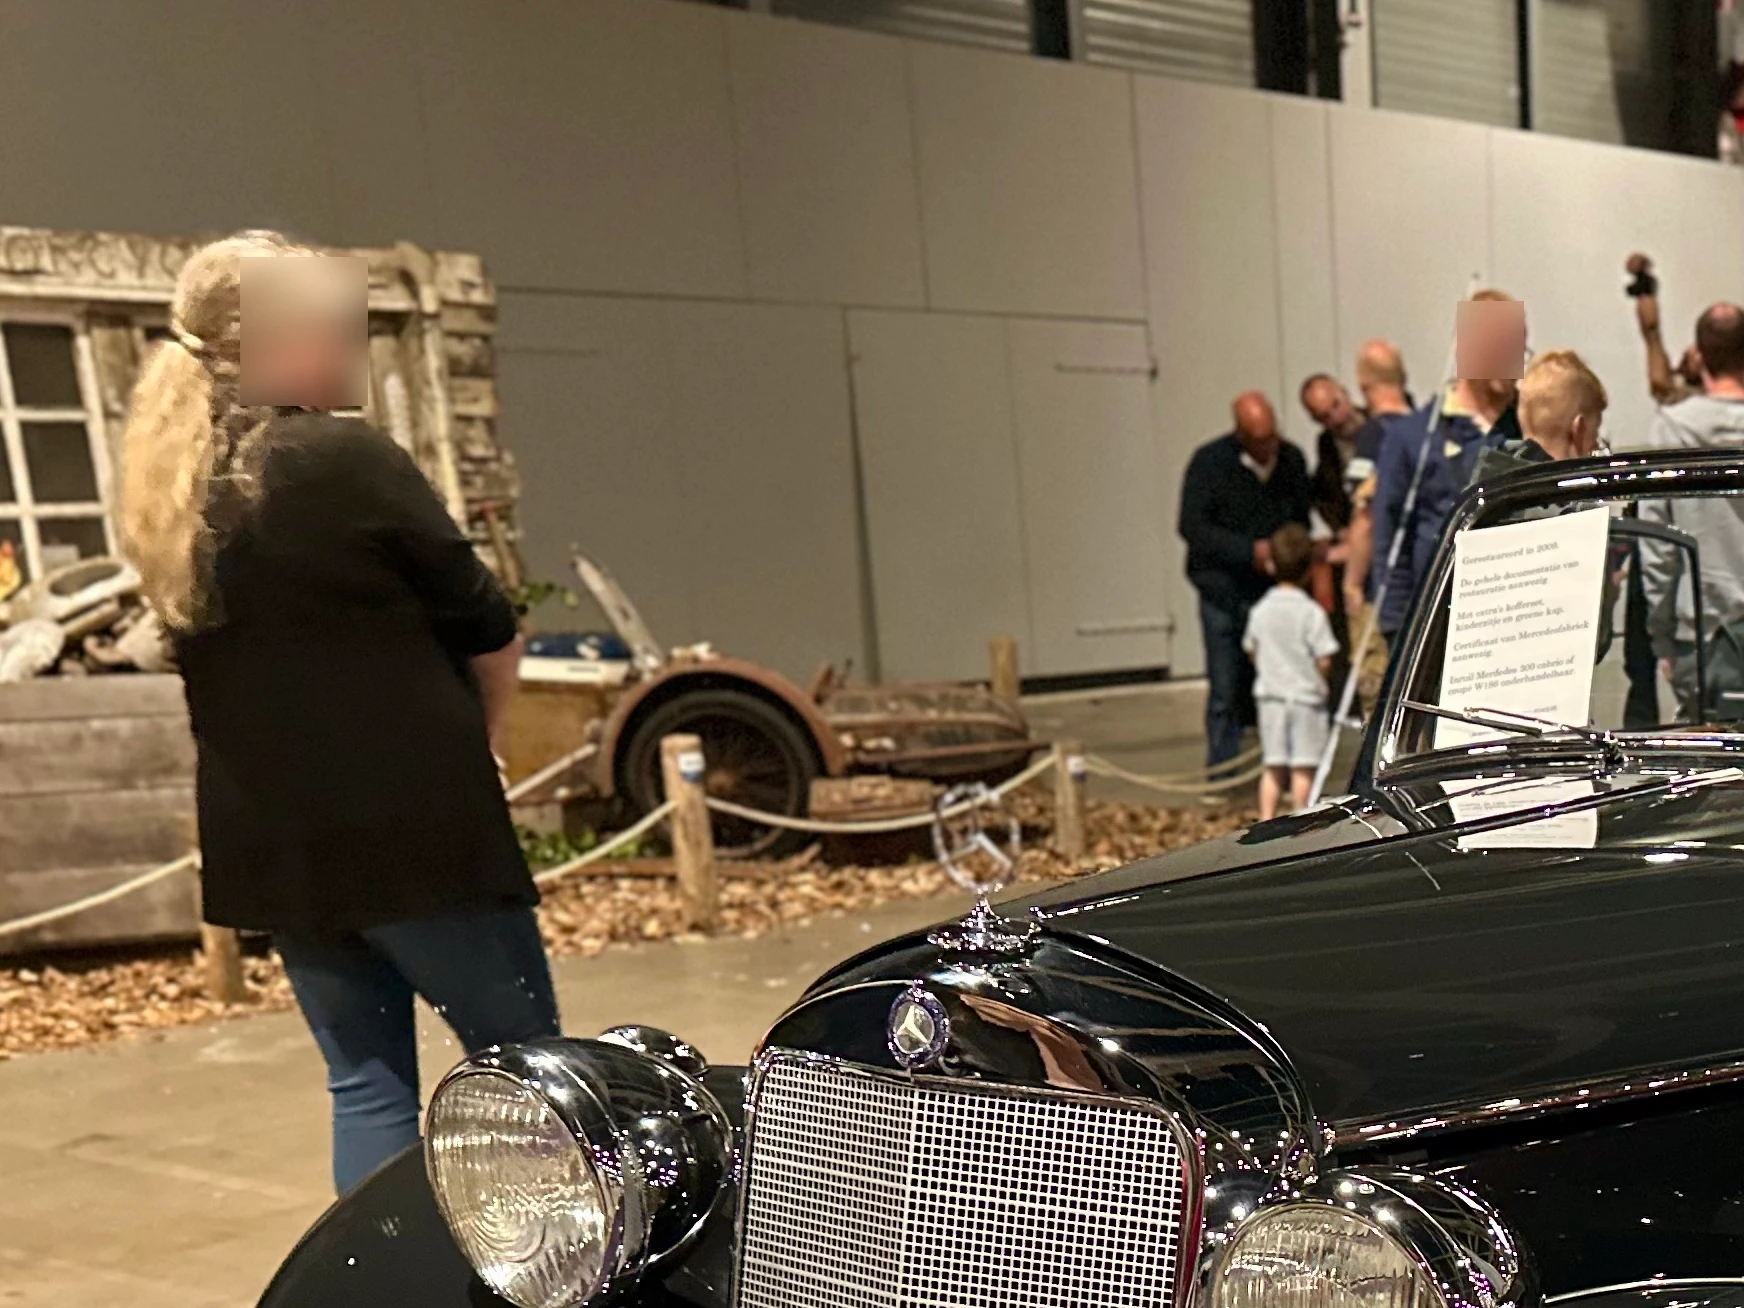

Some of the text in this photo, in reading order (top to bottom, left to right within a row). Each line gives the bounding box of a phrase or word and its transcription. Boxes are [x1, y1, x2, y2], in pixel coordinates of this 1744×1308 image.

[1526, 546, 1535, 555] in
[1503, 563, 1561, 580] documentatie
[1563, 560, 1579, 569] van
[1453, 621, 1589, 652] Certificaat van Mercedesfabriek
[1565, 655, 1575, 665] of
